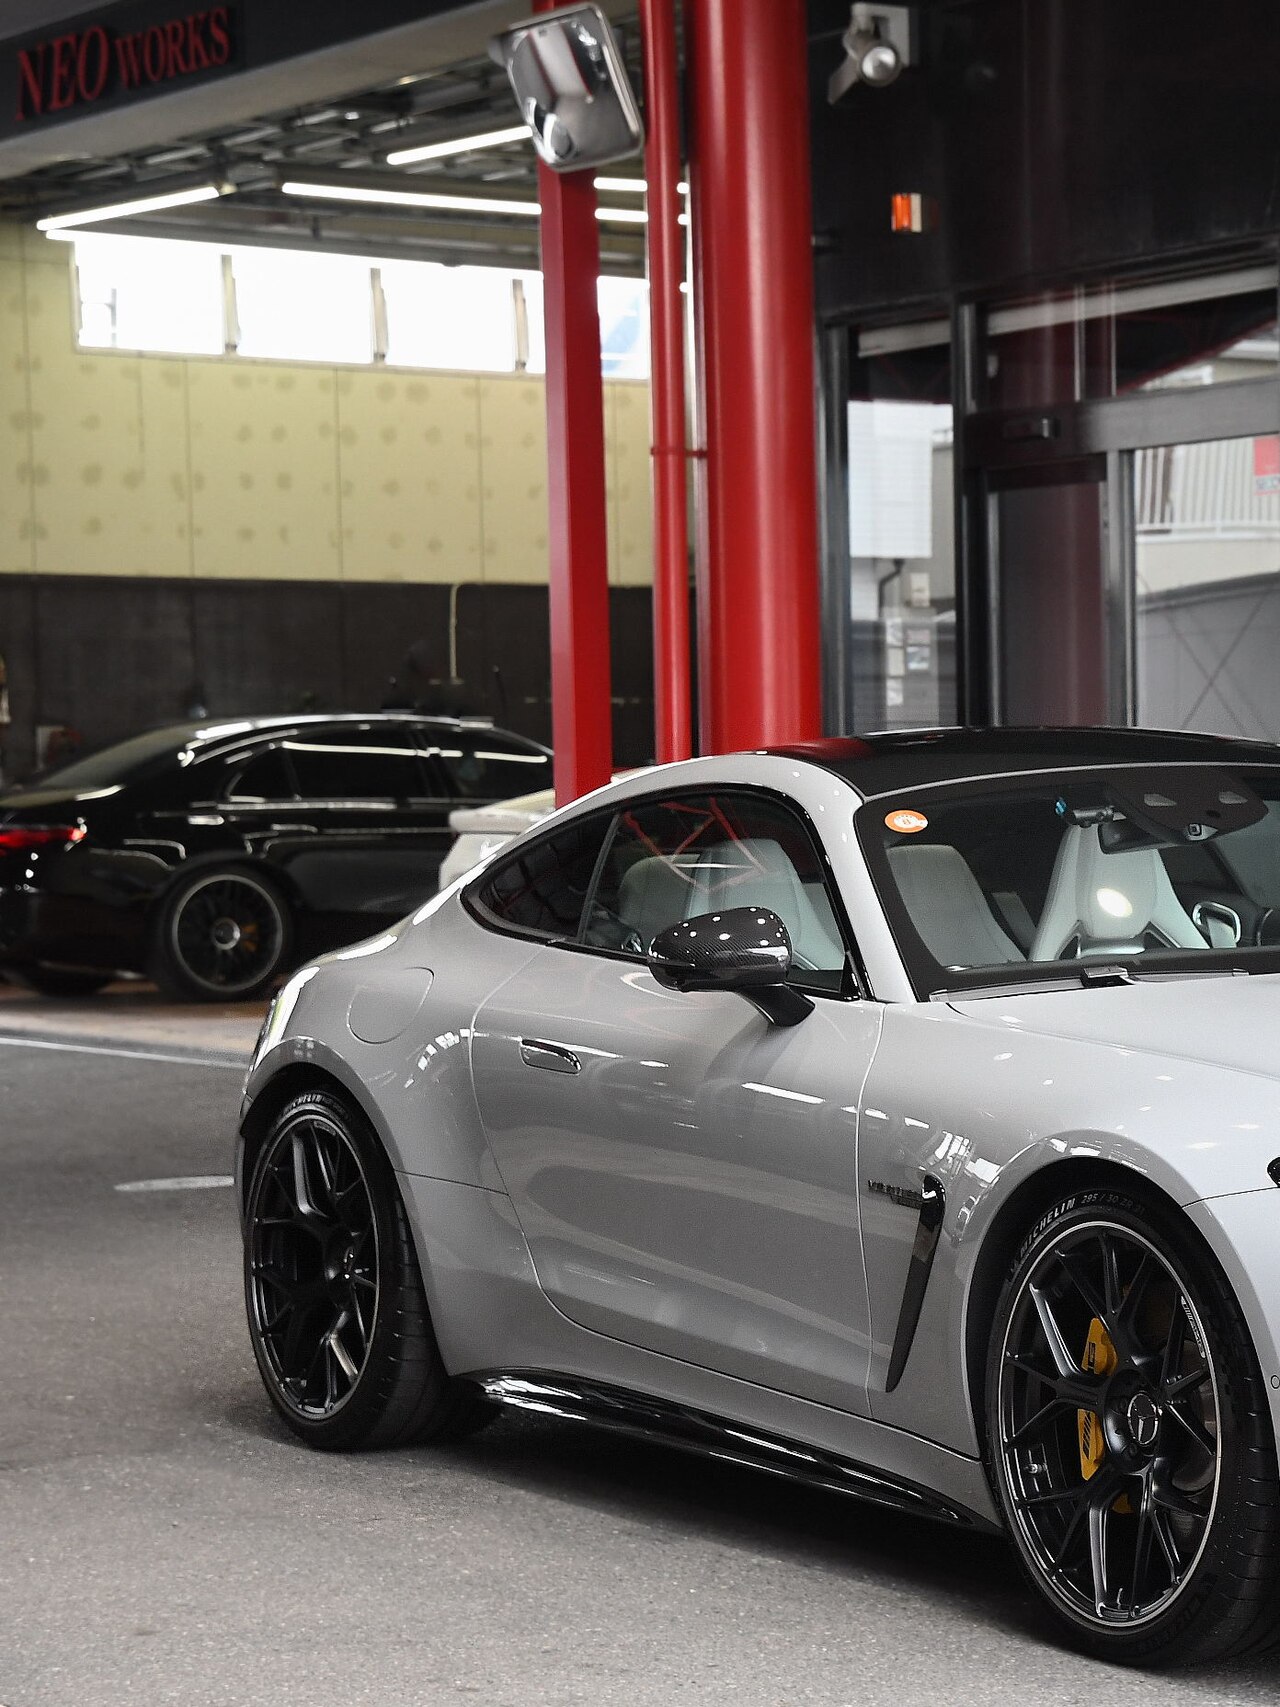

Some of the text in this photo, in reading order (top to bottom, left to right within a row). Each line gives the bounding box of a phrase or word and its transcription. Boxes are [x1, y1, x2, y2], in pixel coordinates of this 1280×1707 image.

[15, 6, 230, 121] NEO WORKS
[1020, 1197, 1076, 1257] MICHELIN
